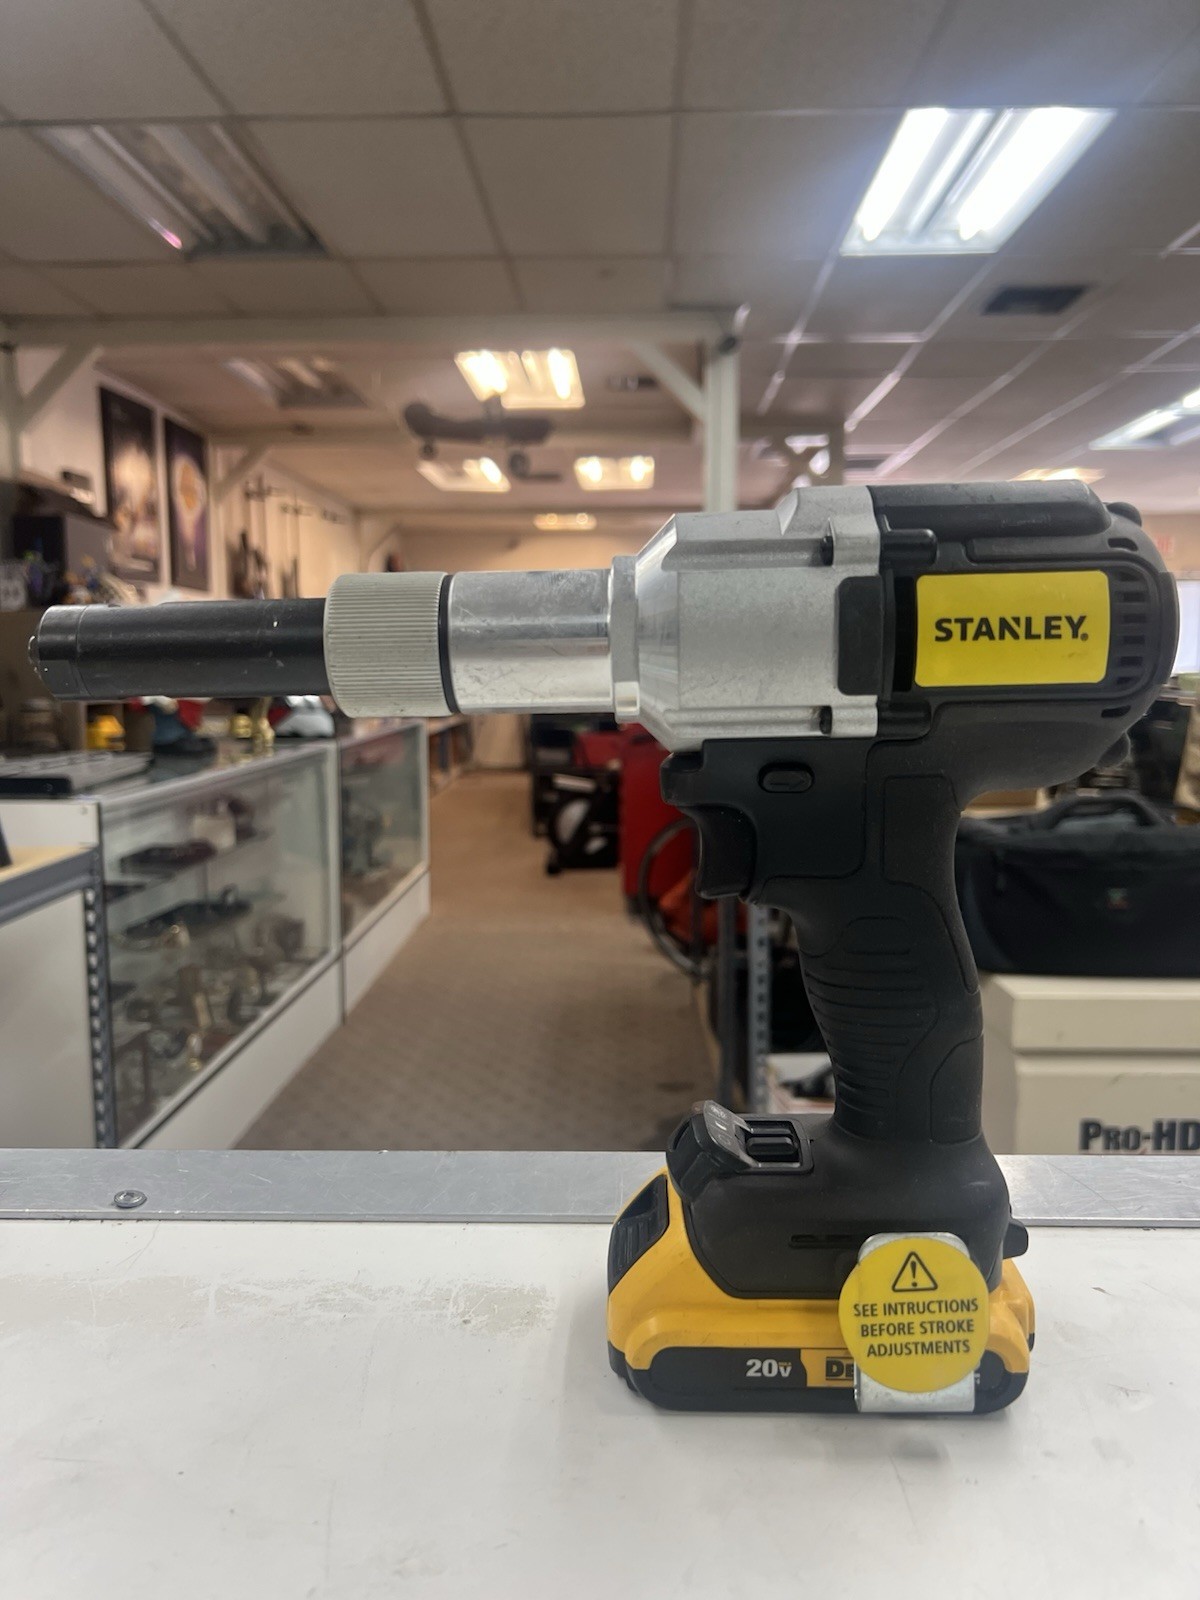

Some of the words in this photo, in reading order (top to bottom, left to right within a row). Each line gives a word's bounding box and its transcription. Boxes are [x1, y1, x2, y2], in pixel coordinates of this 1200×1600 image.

[935, 615, 1086, 642] STANLEY
[853, 1303, 878, 1317] SEE
[883, 1298, 979, 1316] INTRUCTIONS
[860, 1322, 915, 1337] BEFORE
[919, 1319, 974, 1335] STROKE
[867, 1339, 970, 1358] ADJUSTMENTS
